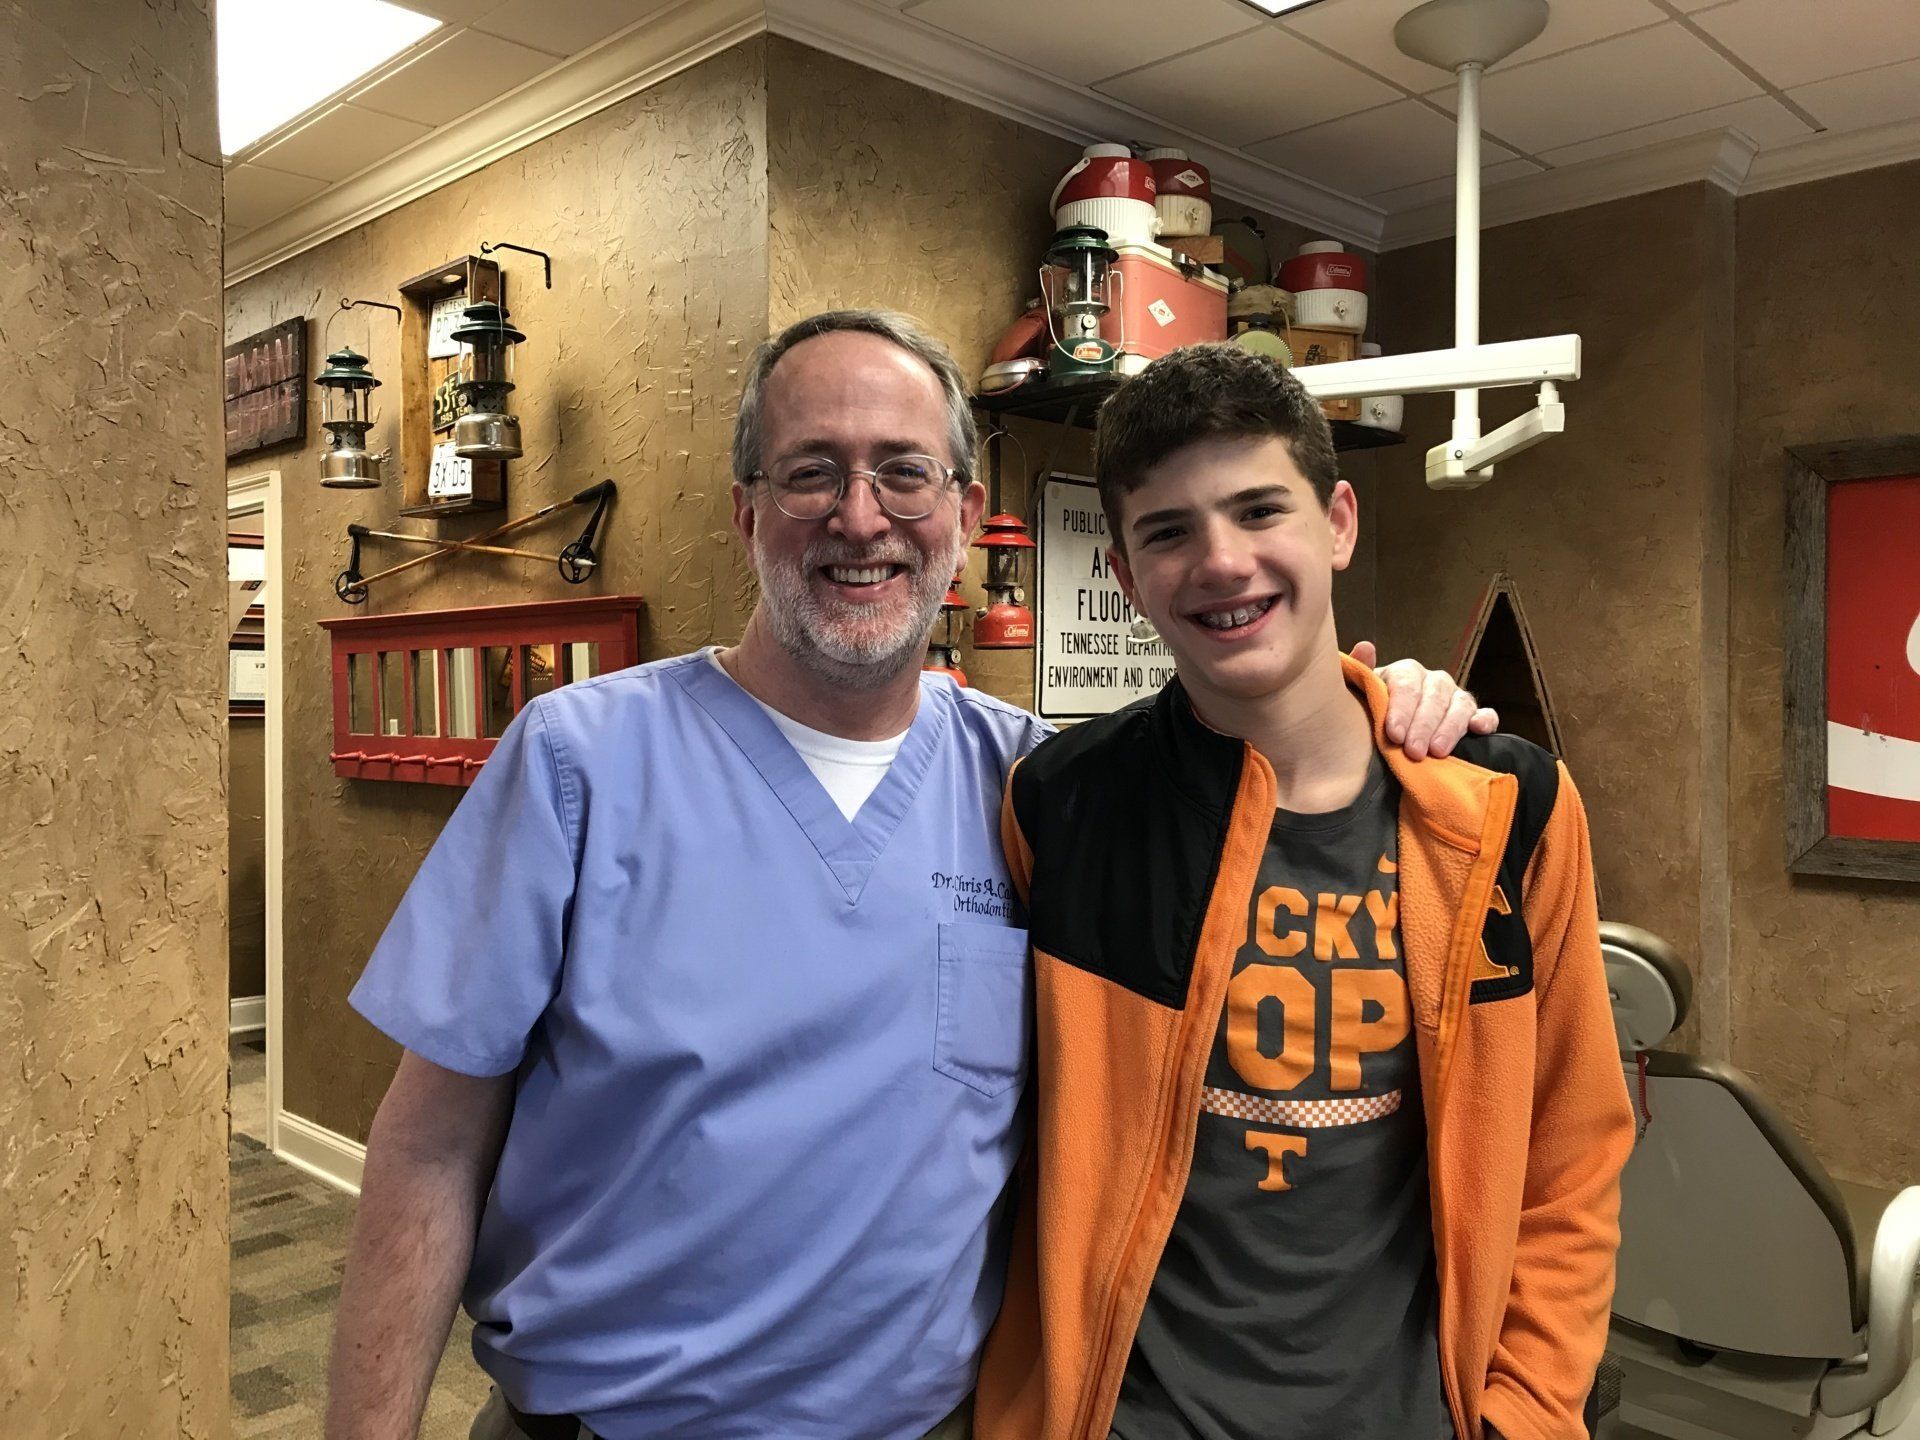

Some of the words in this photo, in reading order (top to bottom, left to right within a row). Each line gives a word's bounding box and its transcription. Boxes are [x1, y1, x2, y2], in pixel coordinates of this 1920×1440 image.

[1063, 508, 1105, 535] PUBLIC
[1060, 632, 1119, 655] TENNESSEE
[1048, 665, 1118, 688] ENVIRONMENT
[1123, 667, 1143, 688] AND
[931, 871, 955, 889] Dr.
[1226, 962, 1412, 1092] OP
[1244, 1130, 1308, 1192] T
